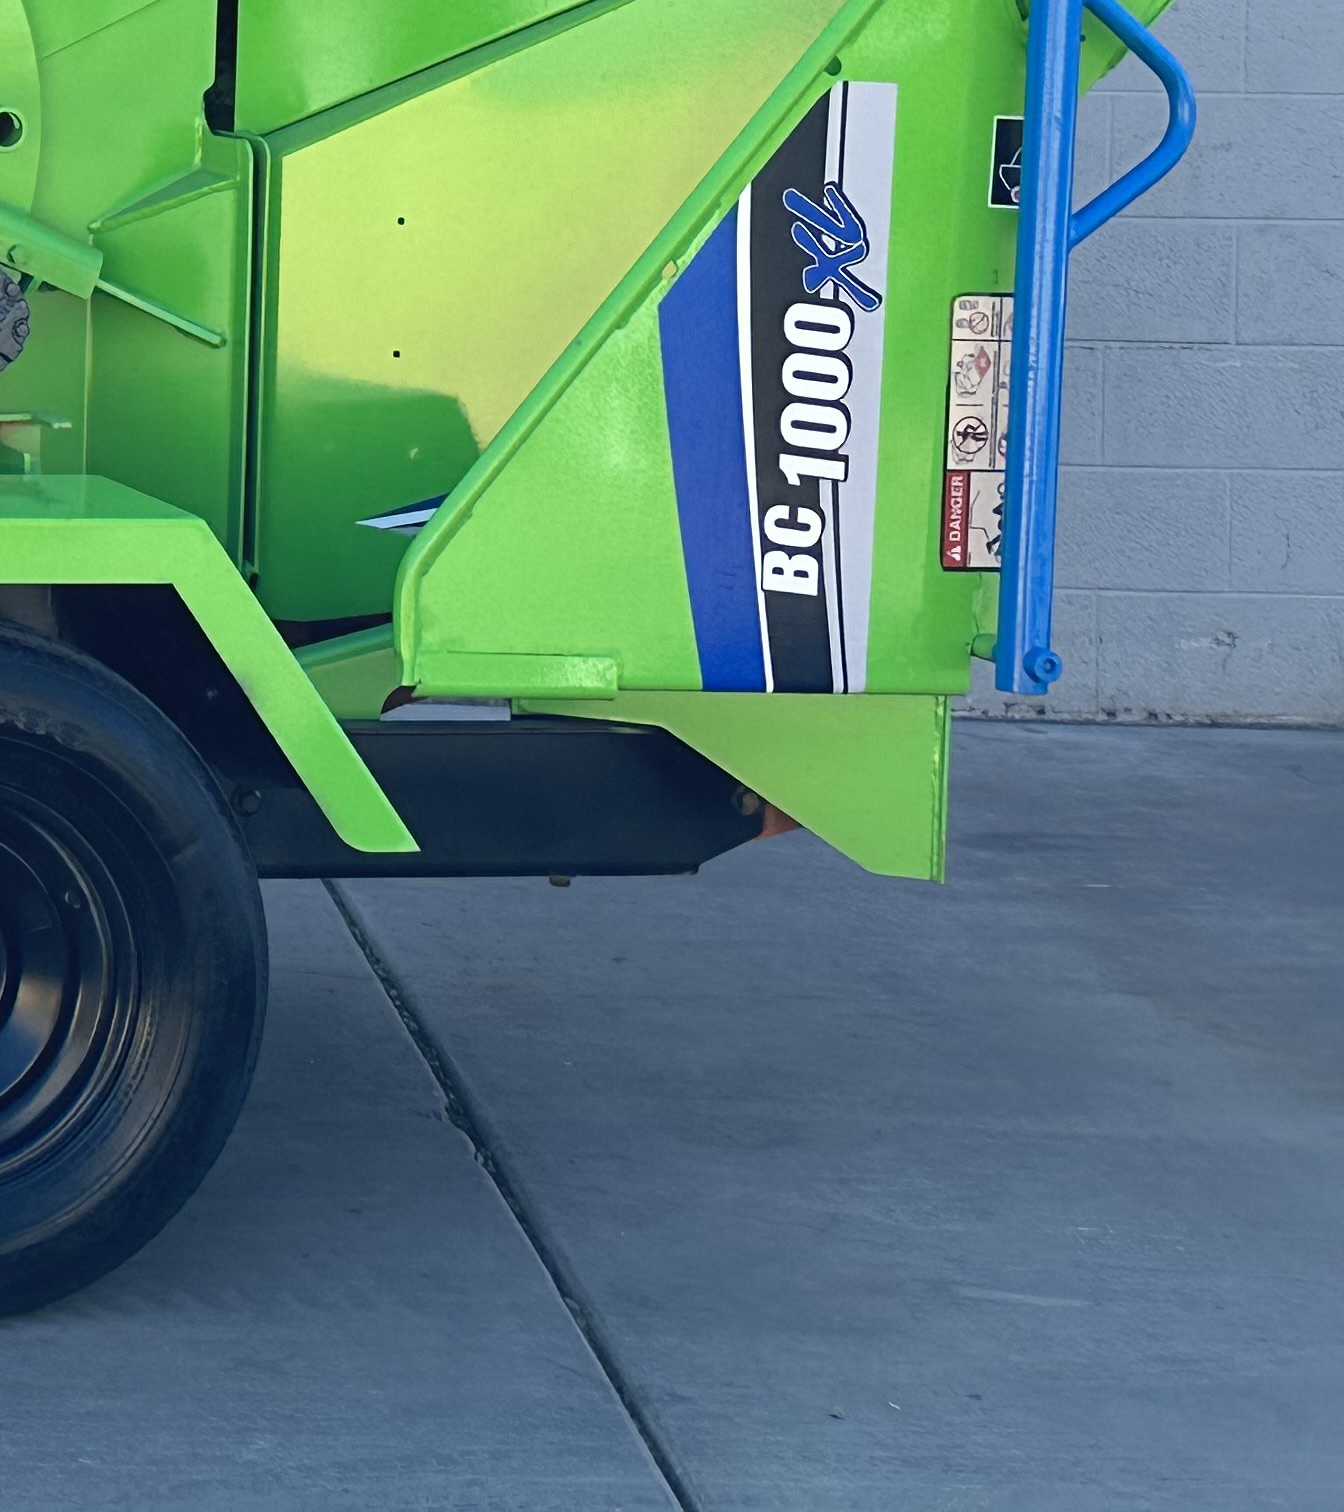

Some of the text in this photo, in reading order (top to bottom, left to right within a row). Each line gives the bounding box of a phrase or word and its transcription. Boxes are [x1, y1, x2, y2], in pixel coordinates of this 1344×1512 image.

[779, 301, 854, 486] 1000
[762, 504, 823, 597] BC
[949, 475, 964, 542] DANGER
